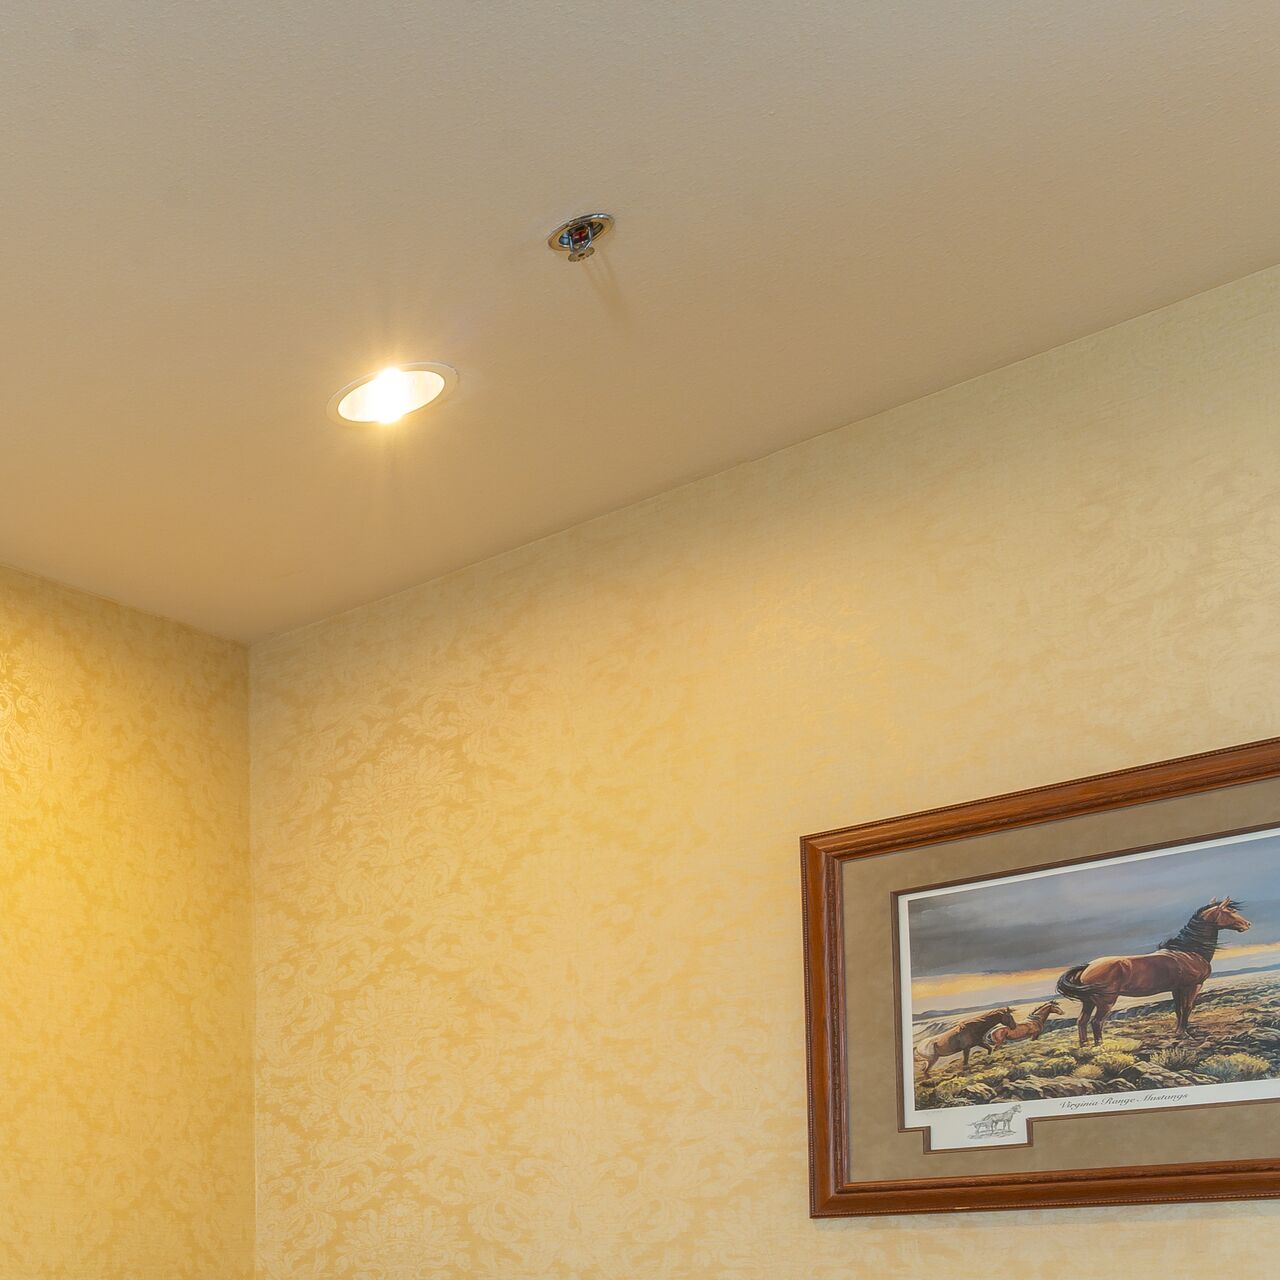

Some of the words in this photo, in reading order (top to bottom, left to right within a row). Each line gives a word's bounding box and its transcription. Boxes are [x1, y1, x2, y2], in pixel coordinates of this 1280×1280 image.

[1059, 1101, 1098, 1110] Virginia
[1101, 1097, 1137, 1106] Range
[1138, 1094, 1188, 1103] Mustangs
